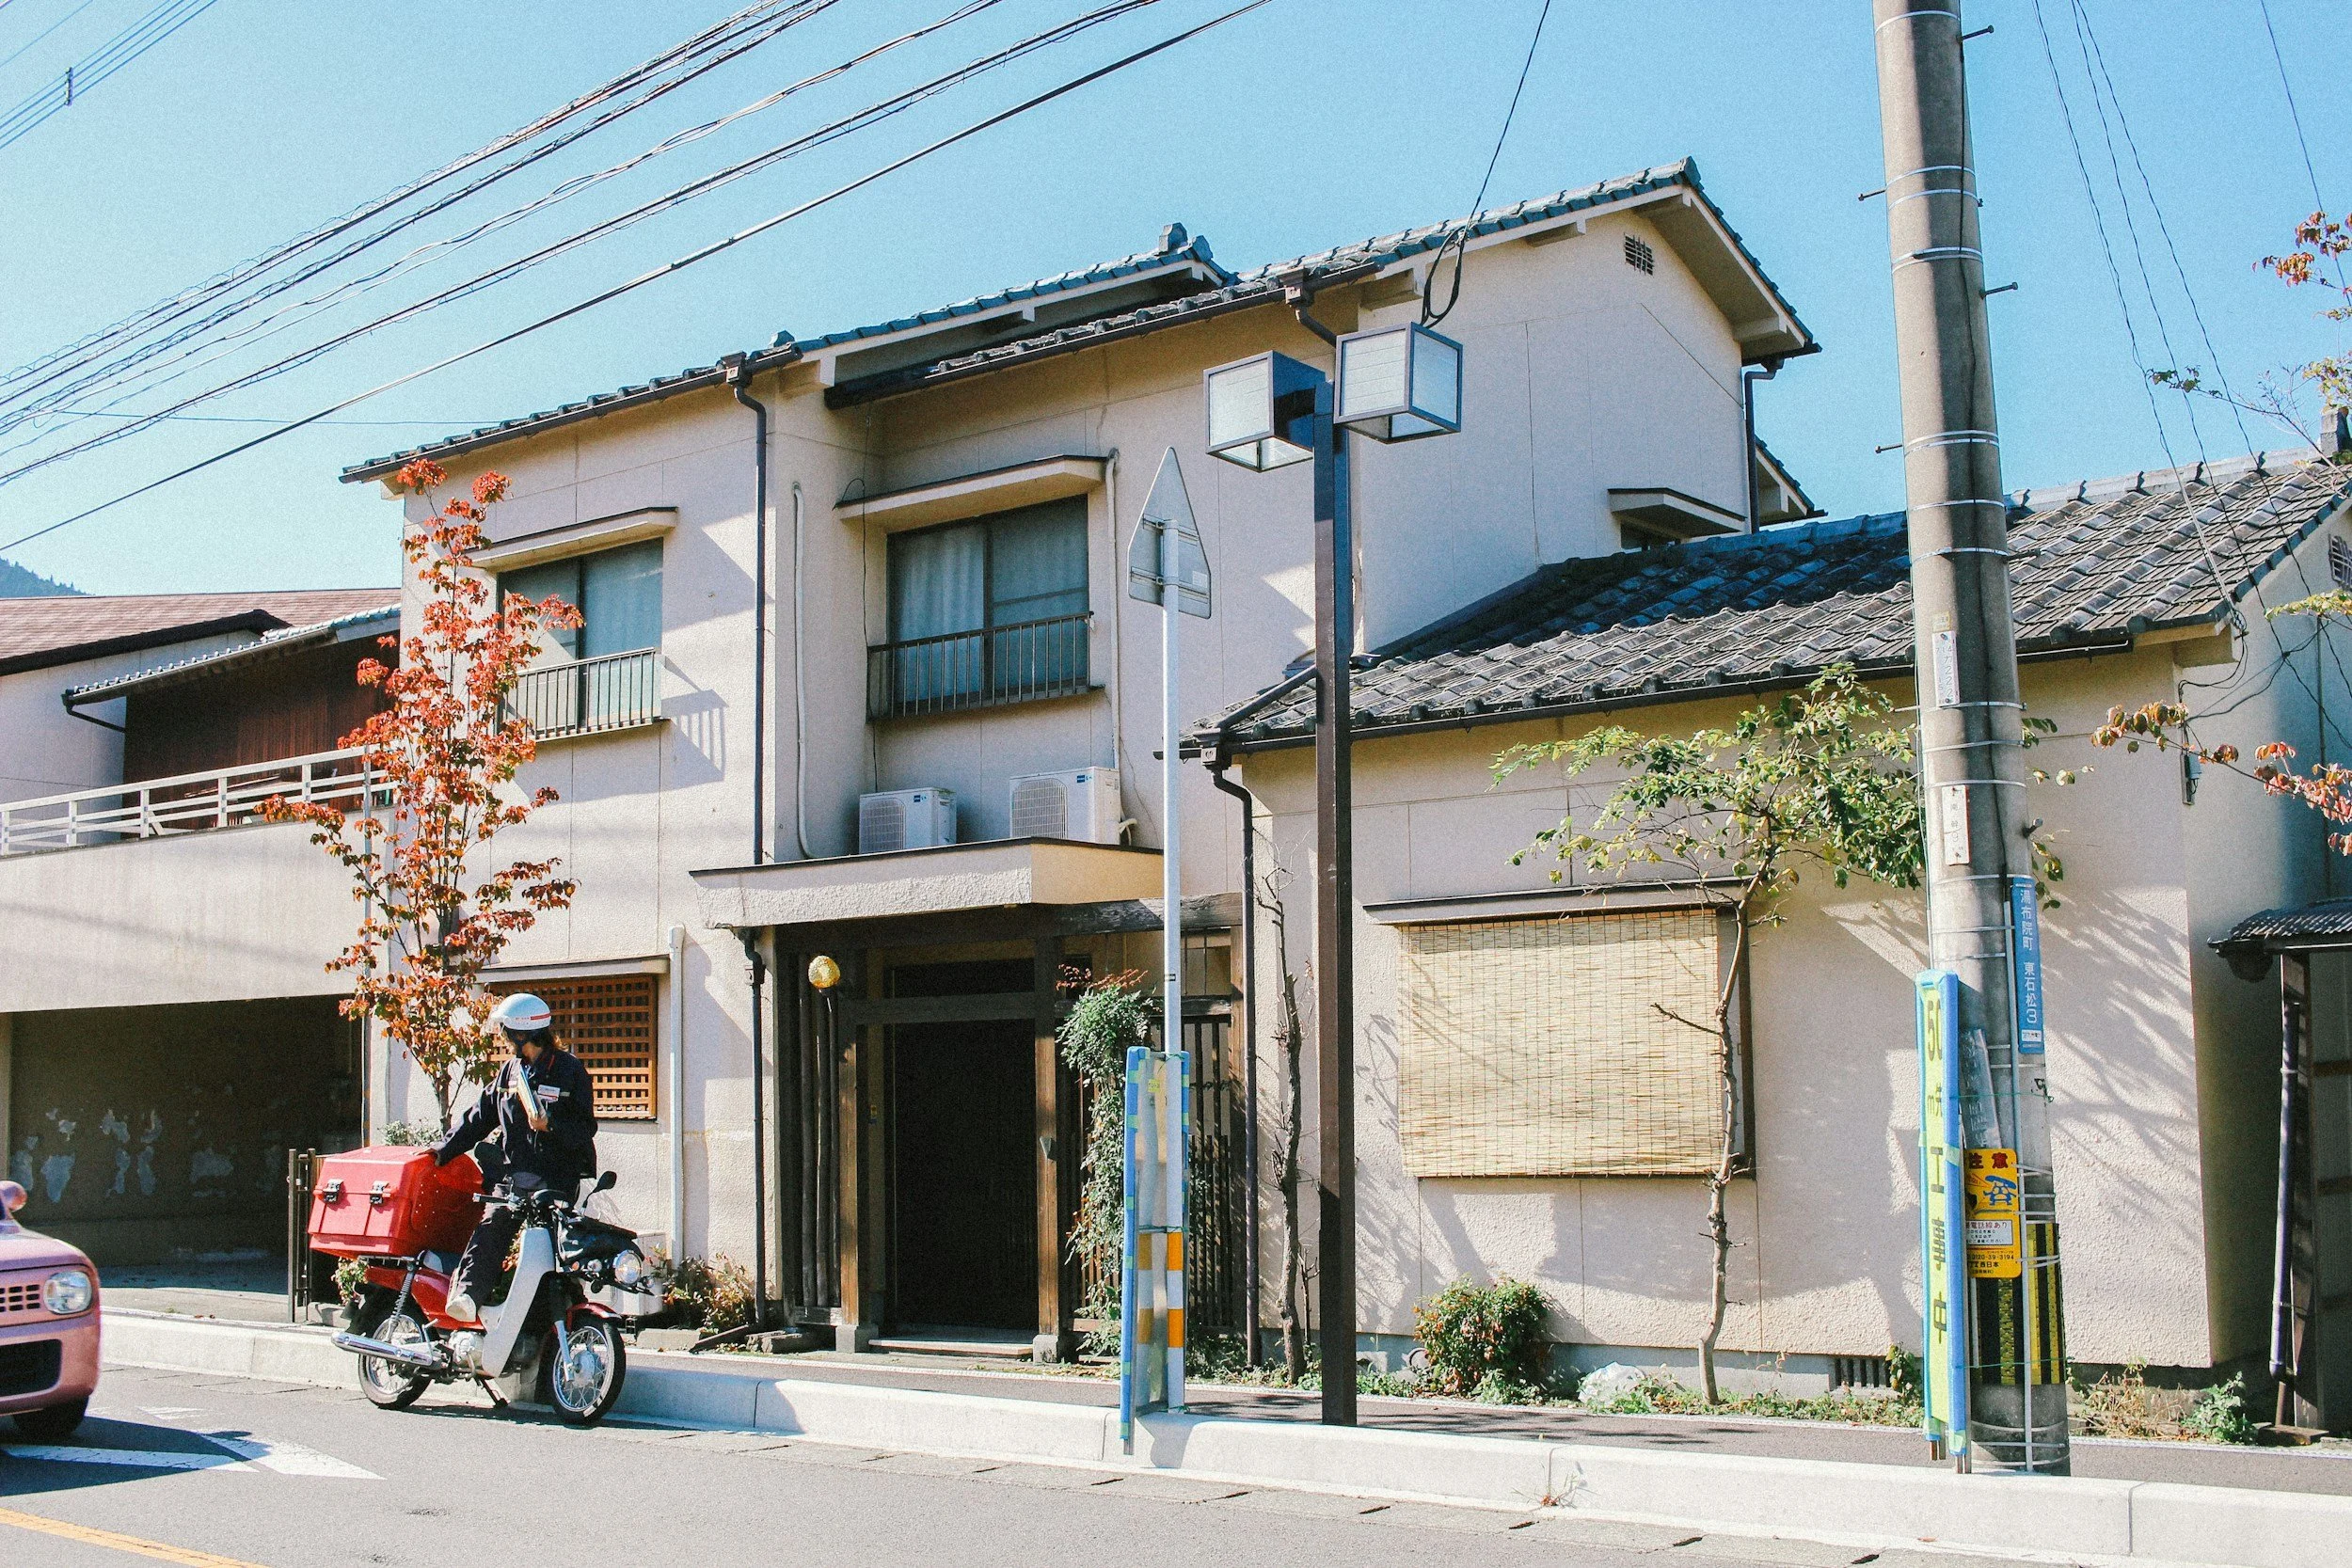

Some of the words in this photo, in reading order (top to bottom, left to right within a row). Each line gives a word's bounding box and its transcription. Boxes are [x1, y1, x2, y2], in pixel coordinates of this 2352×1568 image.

[2021, 889, 2033, 951] 湯布院町
[2024, 961, 2037, 1023] 東石松3
[1969, 1152, 2008, 1168] 注意
